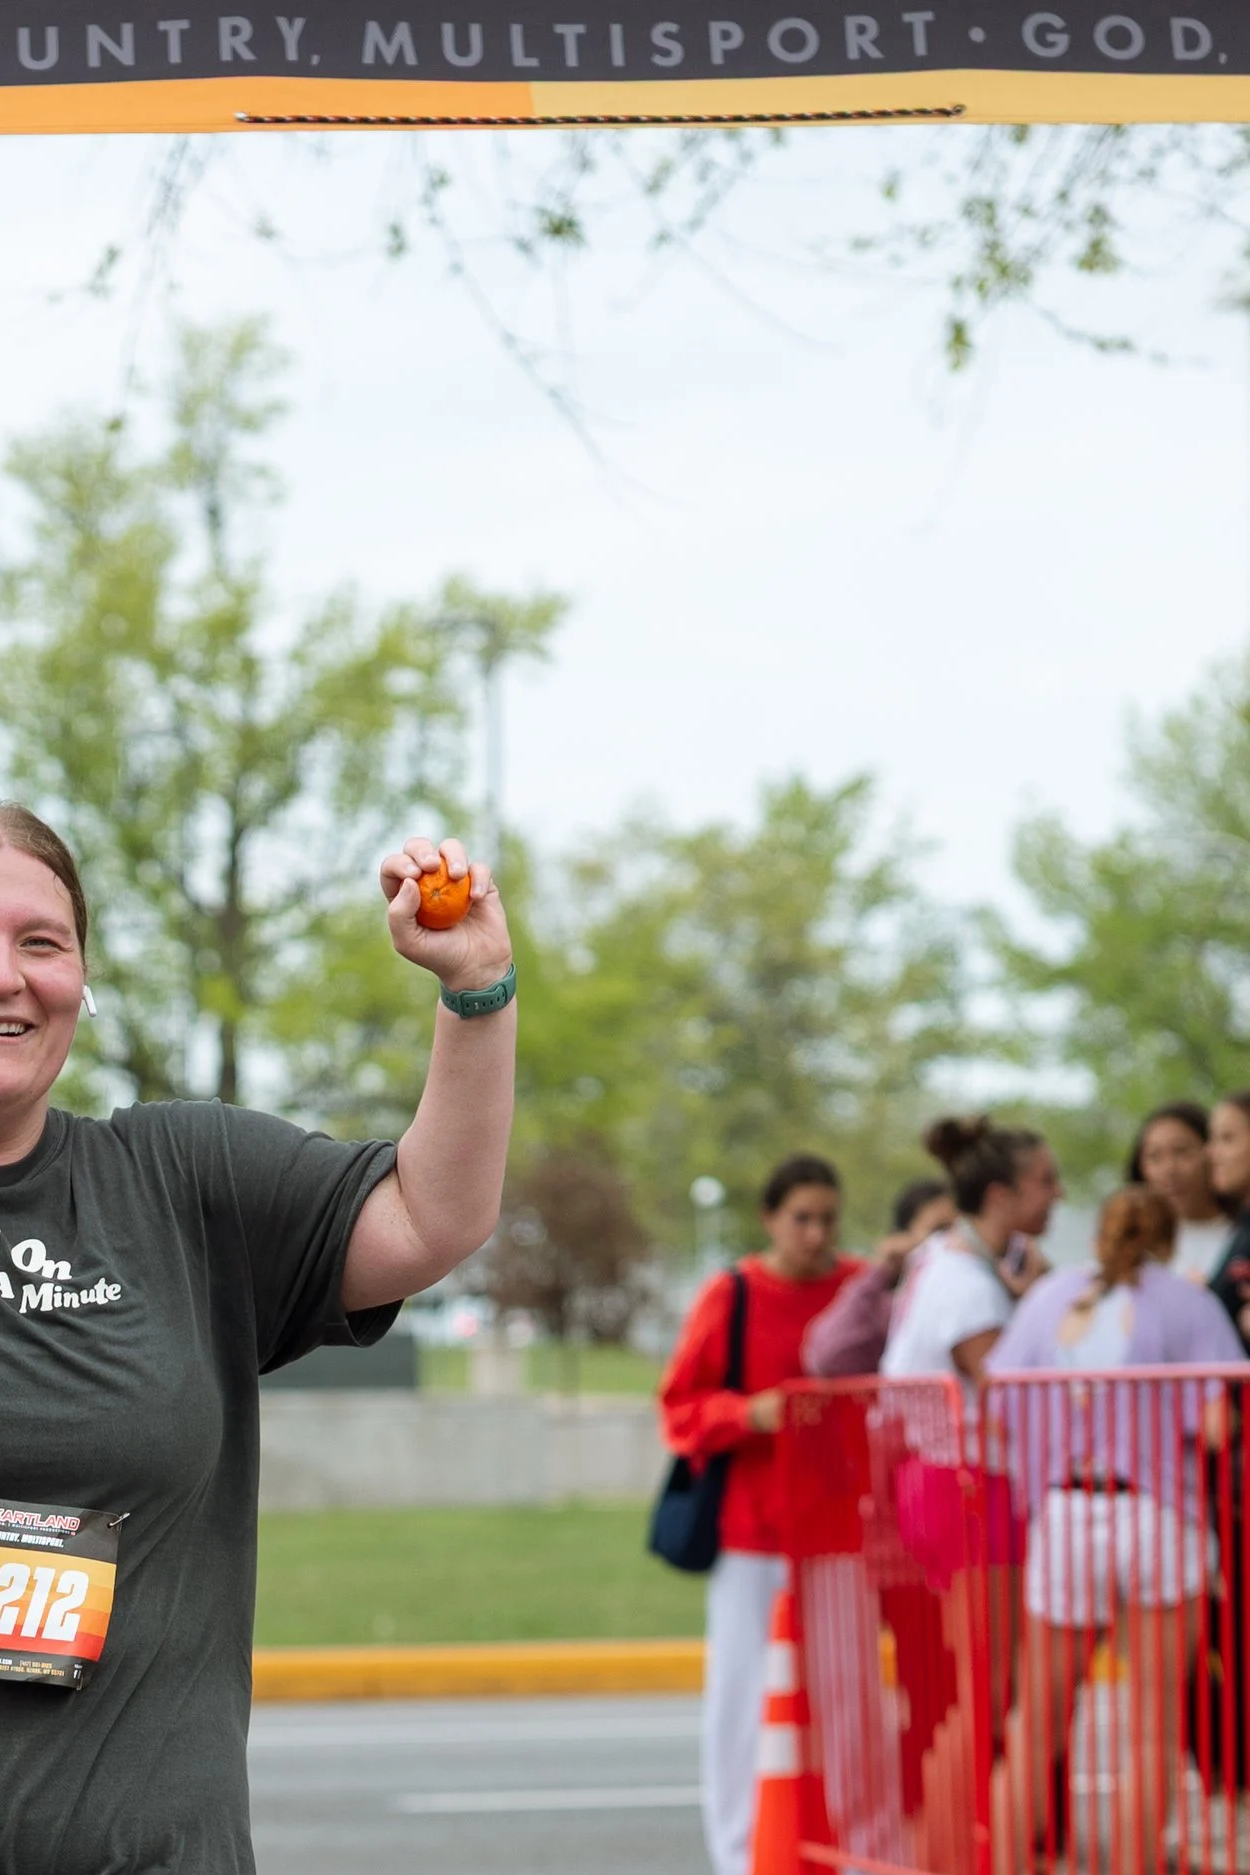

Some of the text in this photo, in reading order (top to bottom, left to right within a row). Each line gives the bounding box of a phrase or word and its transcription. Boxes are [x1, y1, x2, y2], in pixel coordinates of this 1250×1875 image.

[361, 10, 936, 69] MULTISPORT
[1021, 12, 1229, 65] GOD,
[10, 1238, 73, 1281] On
[18, 1277, 122, 1314] Minute
